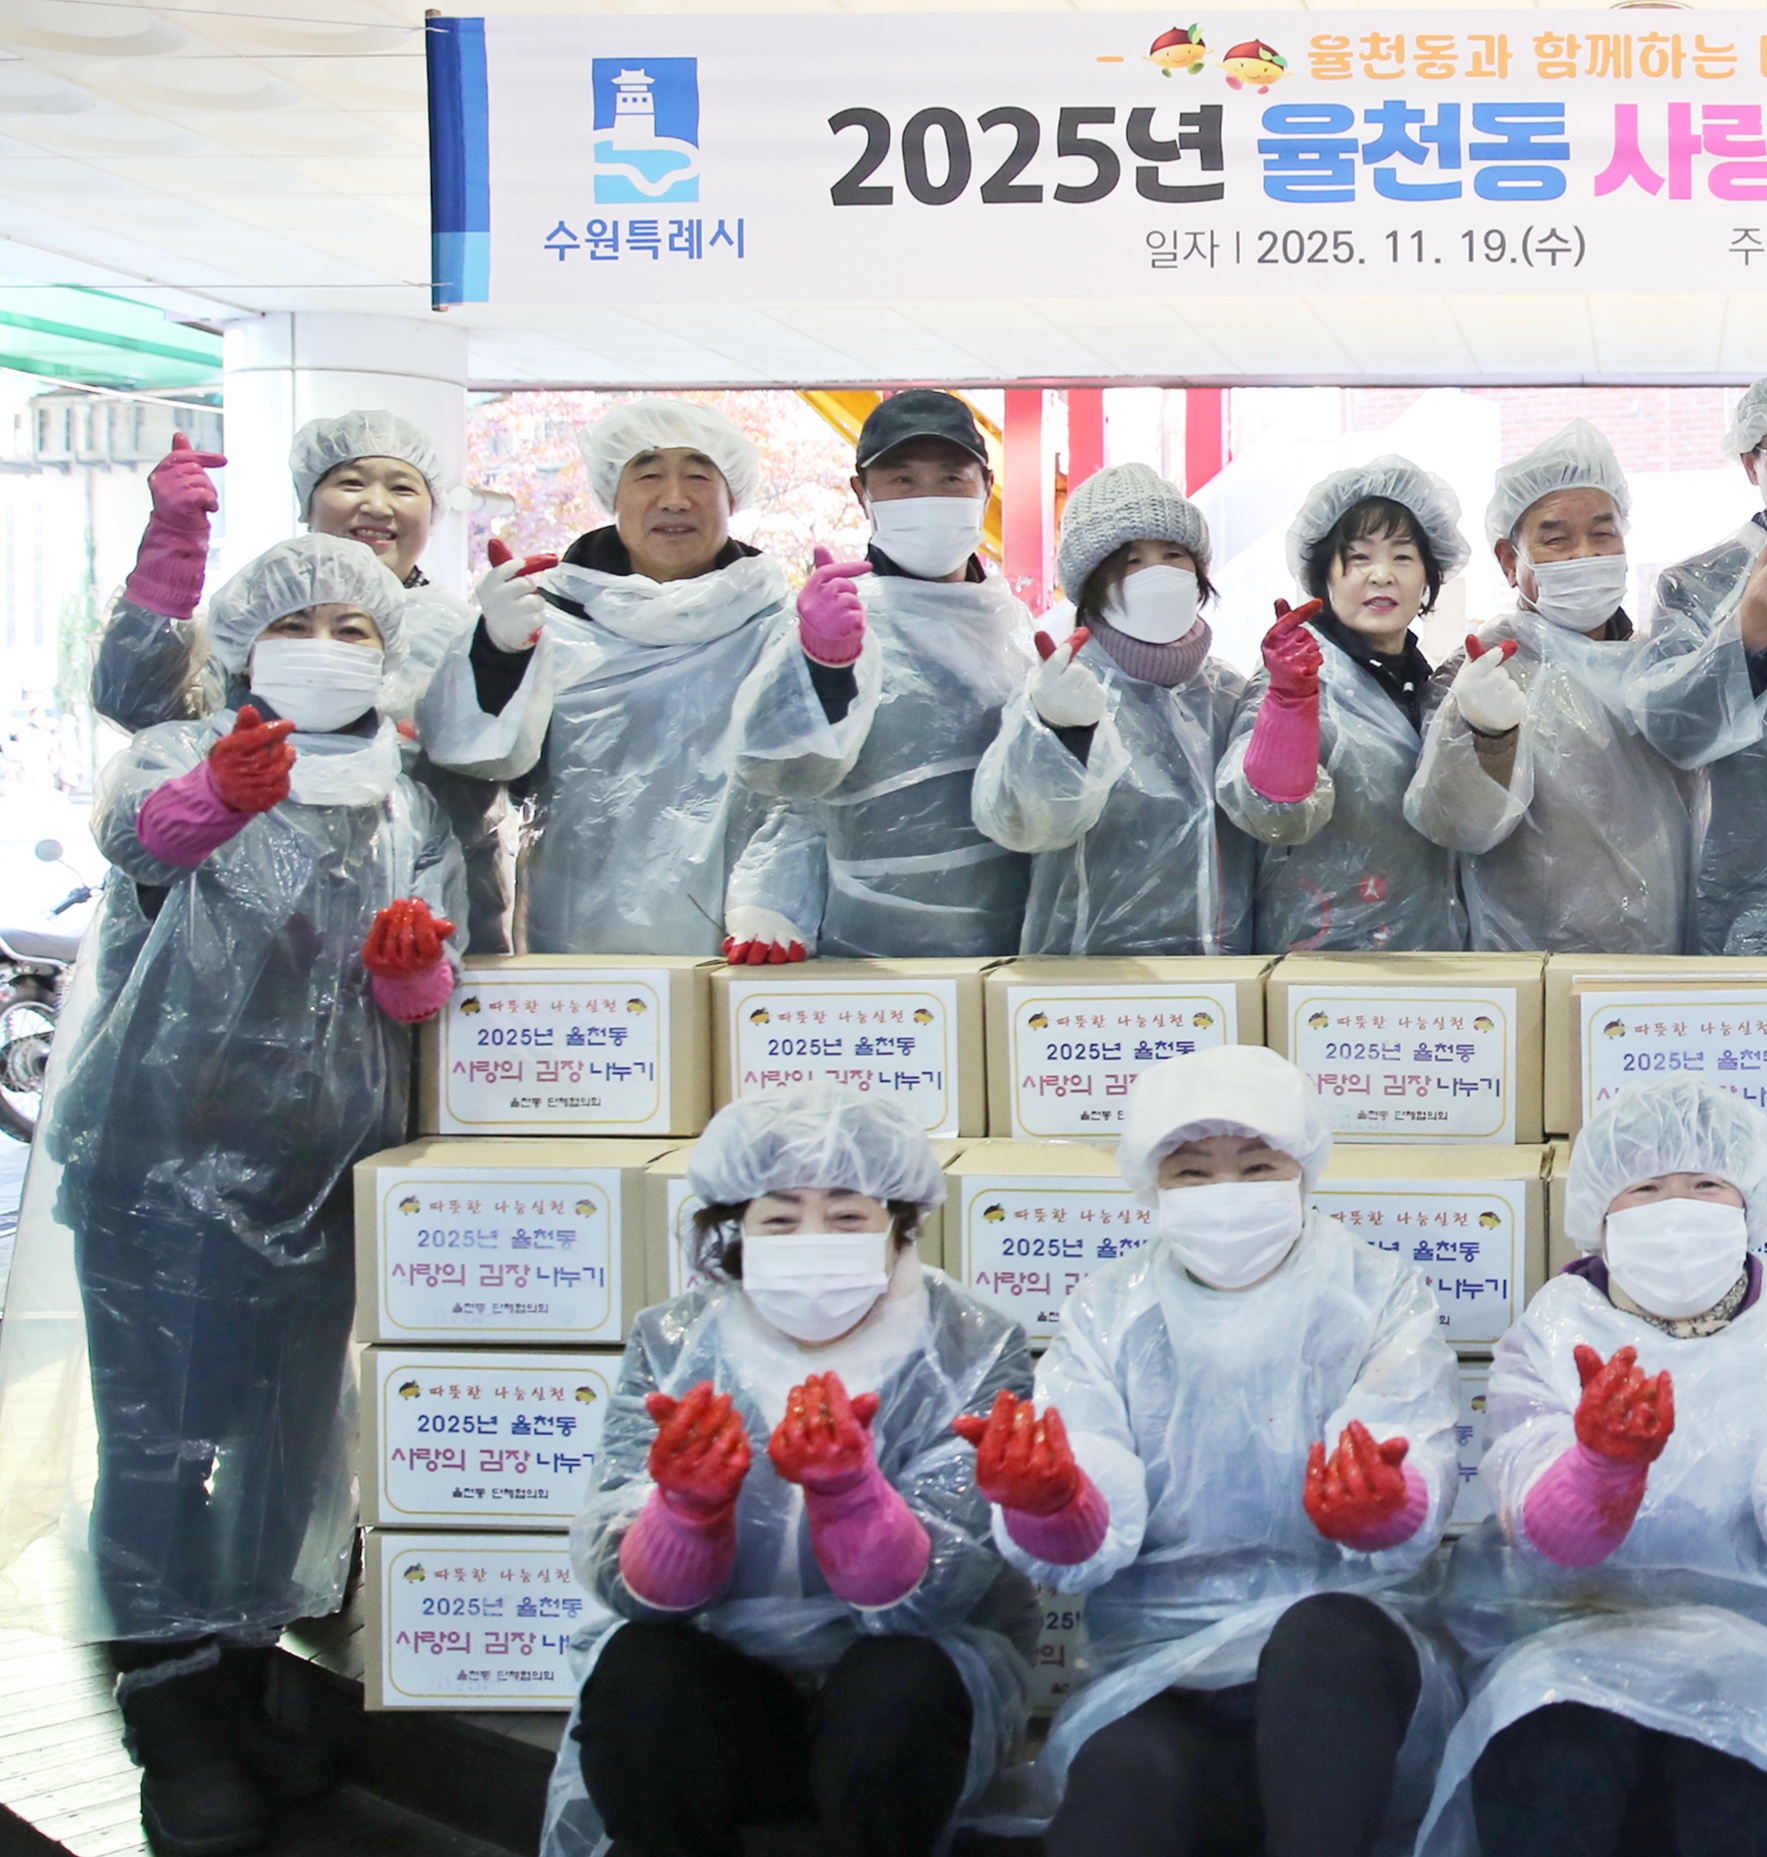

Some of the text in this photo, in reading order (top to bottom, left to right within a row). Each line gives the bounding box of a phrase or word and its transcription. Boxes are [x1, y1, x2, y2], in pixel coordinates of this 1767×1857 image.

[1307, 32, 1514, 80] 율천동과
[1532, 32, 1738, 80] 함께하는
[827, 103, 1225, 207] 2025년
[1256, 90, 1571, 204] 율천동
[543, 217, 746, 262] 수원특례시
[1145, 225, 1586, 269] 일자 2025. 11. 19.(수)
[489, 1000, 538, 1014] 따뜻한
[478, 1026, 628, 1047] 2025년 율천동
[768, 1036, 916, 1057] 2025년 율천동
[1047, 1042, 1122, 1061] 2025년
[1325, 1042, 1475, 1063] 2025년 율천동
[452, 1060, 654, 1084] 사랑의 김장 나누기
[879, 1071, 942, 1091] 나누기
[1022, 1074, 1092, 1097] 사랑의
[1384, 1075, 1500, 1097] 김장 나누기
[418, 1228, 577, 1251] 2025년 율천동
[391, 1263, 604, 1288] 사랑의 김장 나누기
[418, 1414, 577, 1437] 2025년 율천동
[391, 1448, 531, 1474] 사랑의 김장
[422, 1597, 583, 1619] 2025년 율천동
[395, 1631, 537, 1656] 사랑의 김장
